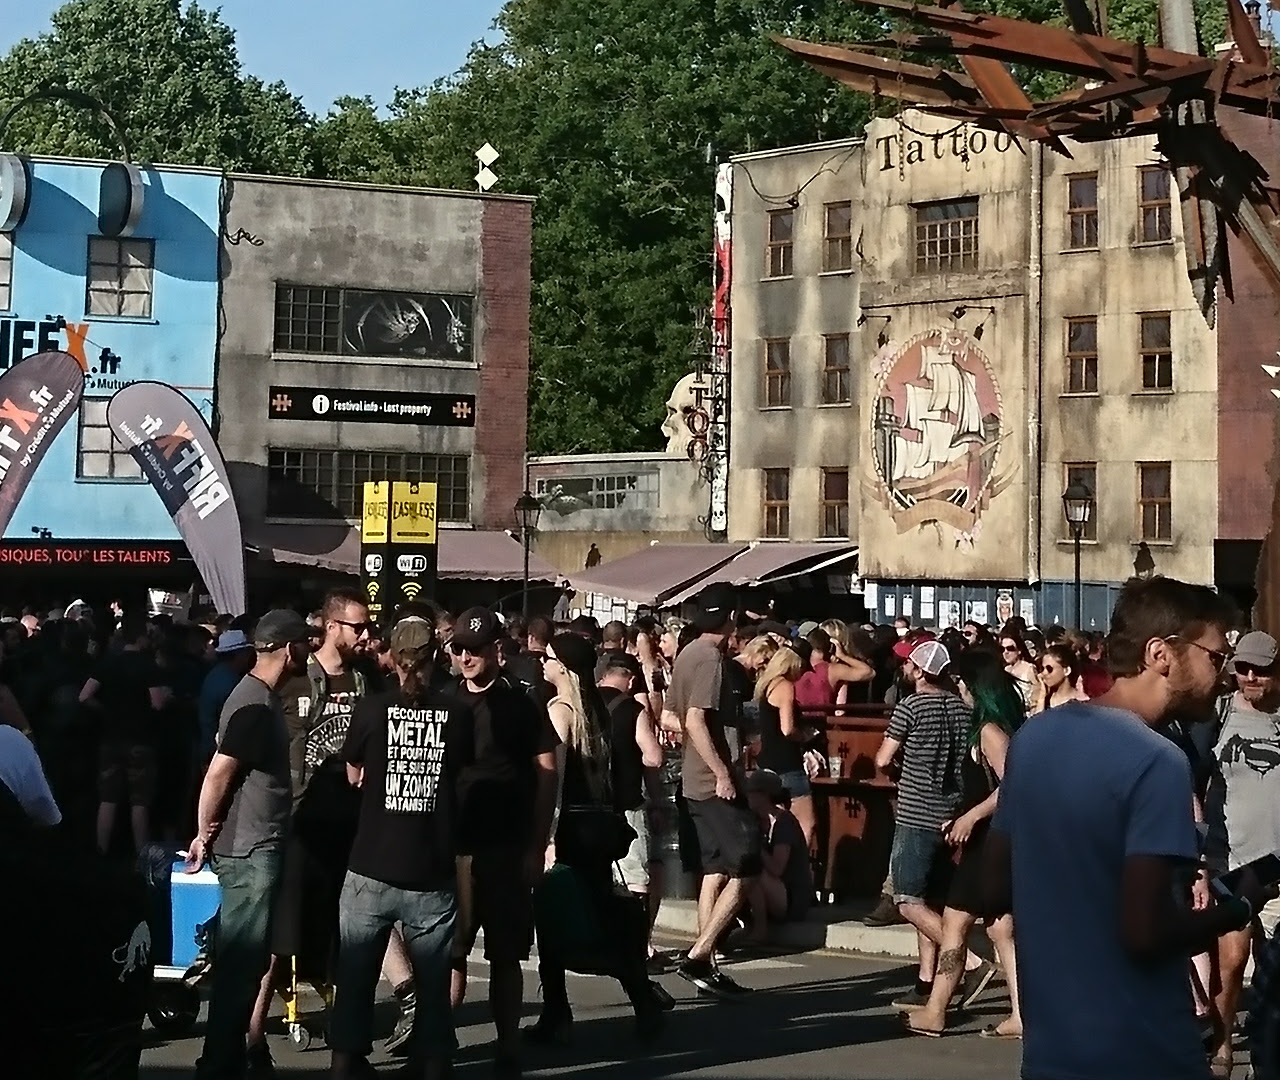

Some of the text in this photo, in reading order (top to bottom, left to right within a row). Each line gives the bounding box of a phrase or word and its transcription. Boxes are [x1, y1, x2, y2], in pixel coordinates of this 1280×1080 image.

[876, 130, 1013, 171] Tattoo
[333, 400, 432, 416] Festival info Lost property
[20, 453, 32, 467] by
[93, 550, 115, 562] LES
[117, 550, 171, 563] TALENTS
[434, 710, 449, 723] DU
[387, 720, 445, 748] METAL
[387, 746, 445, 761] ET POURTANT
[387, 760, 442, 775] JE NE SUIS PAS
[385, 773, 401, 796] UN
